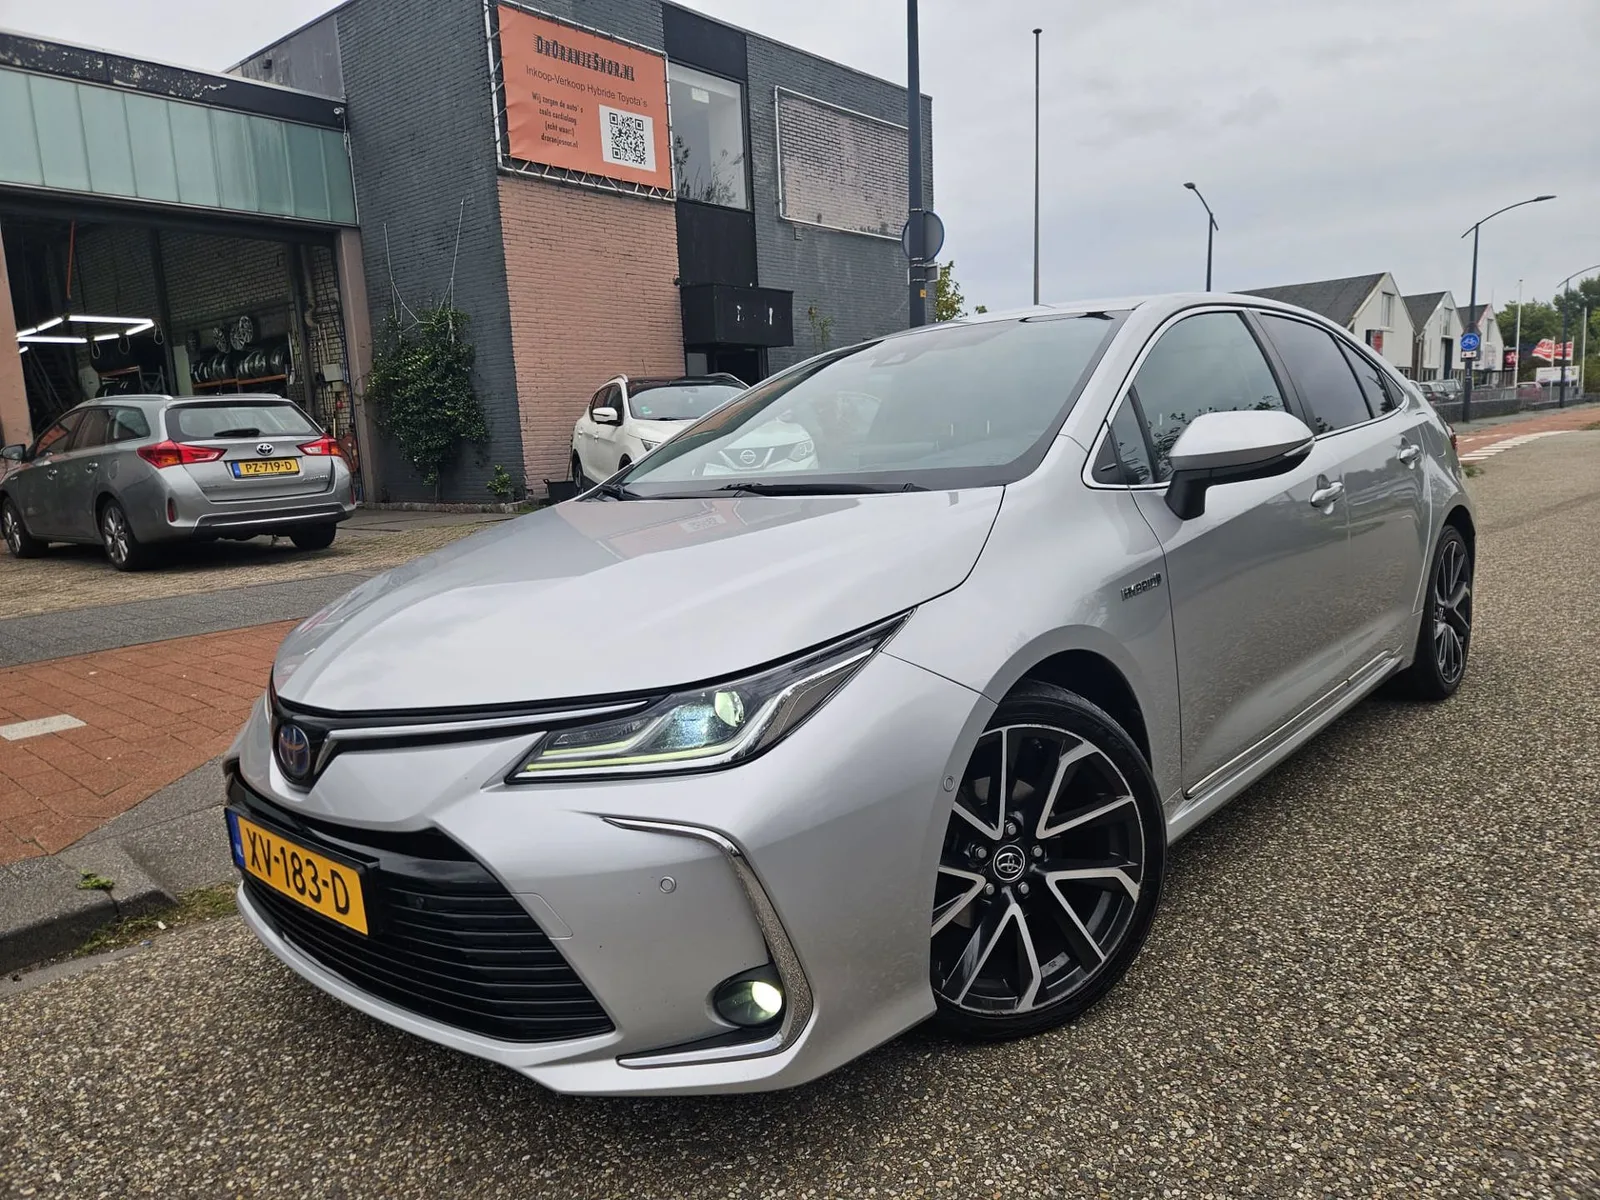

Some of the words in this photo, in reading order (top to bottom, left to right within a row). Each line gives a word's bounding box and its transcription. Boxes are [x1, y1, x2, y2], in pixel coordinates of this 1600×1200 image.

[526, 65, 586, 93] Inkoop-Verkoop
[587, 84, 616, 99] Hybride
[532, 91, 541, 104] Wij
[542, 96, 559, 107] zorgen
[559, 100, 565, 108] de
[552, 112, 577, 126] cardioloog
[245, 461, 292, 473] PZ-719-D
[1120, 571, 1162, 601] HYBRID
[246, 827, 350, 916] XV-183-D
